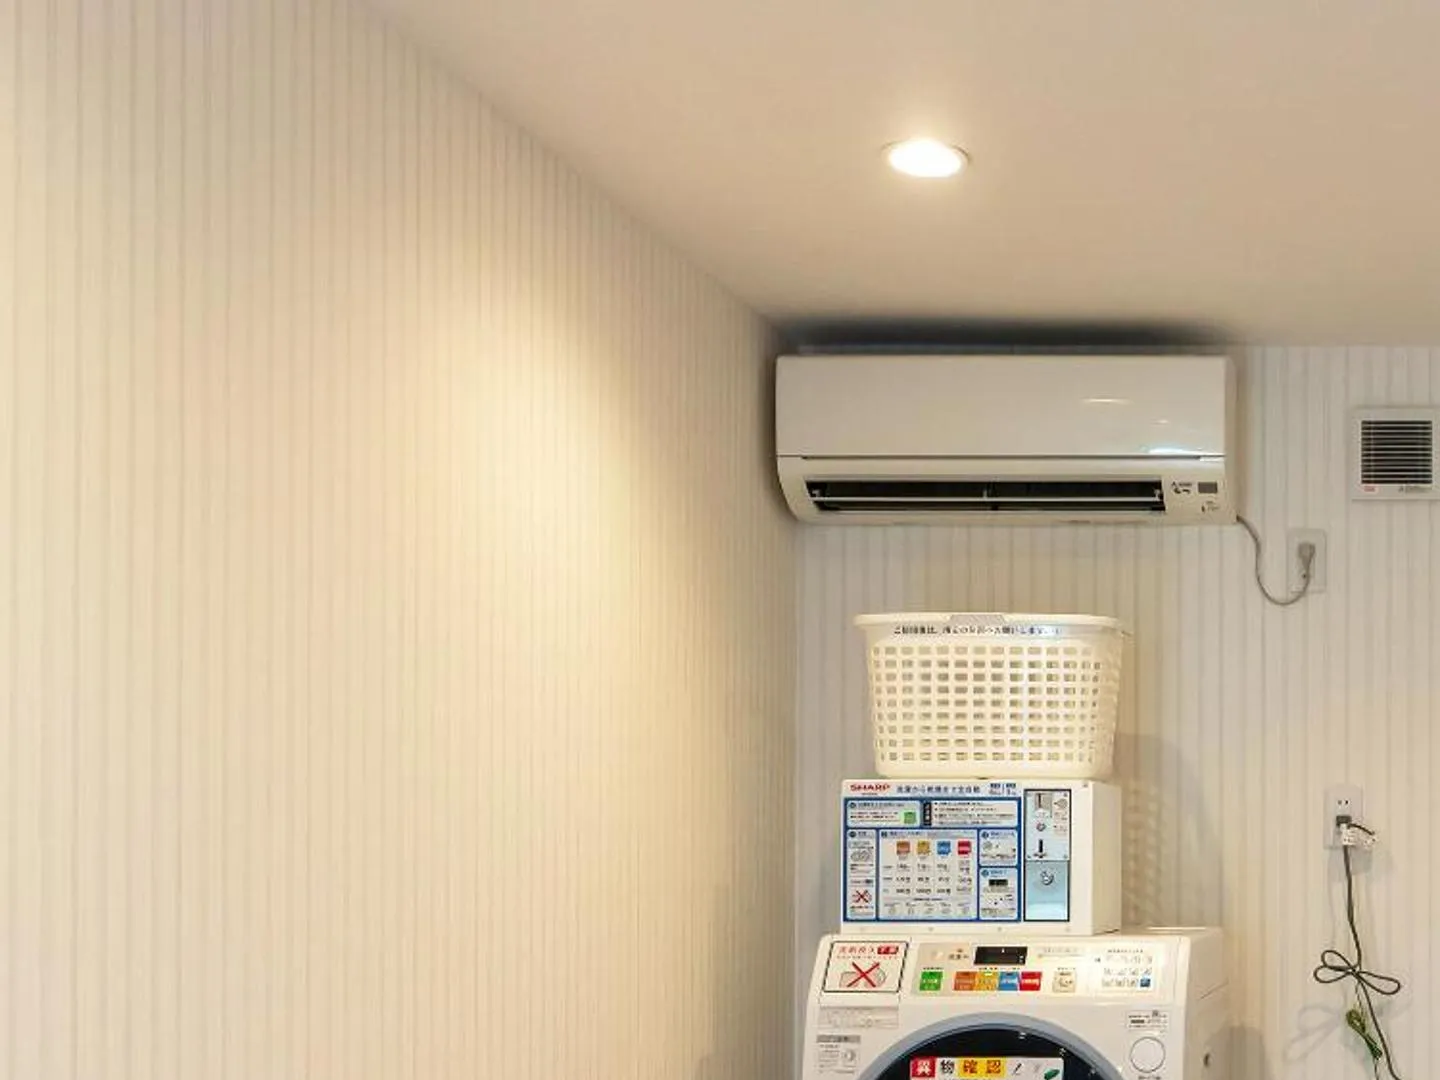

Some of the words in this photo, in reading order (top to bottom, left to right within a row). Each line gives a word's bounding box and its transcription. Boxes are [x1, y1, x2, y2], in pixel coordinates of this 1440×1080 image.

[849, 784, 890, 792] SHARP
[915, 1059, 1001, 1076] 異物確認
